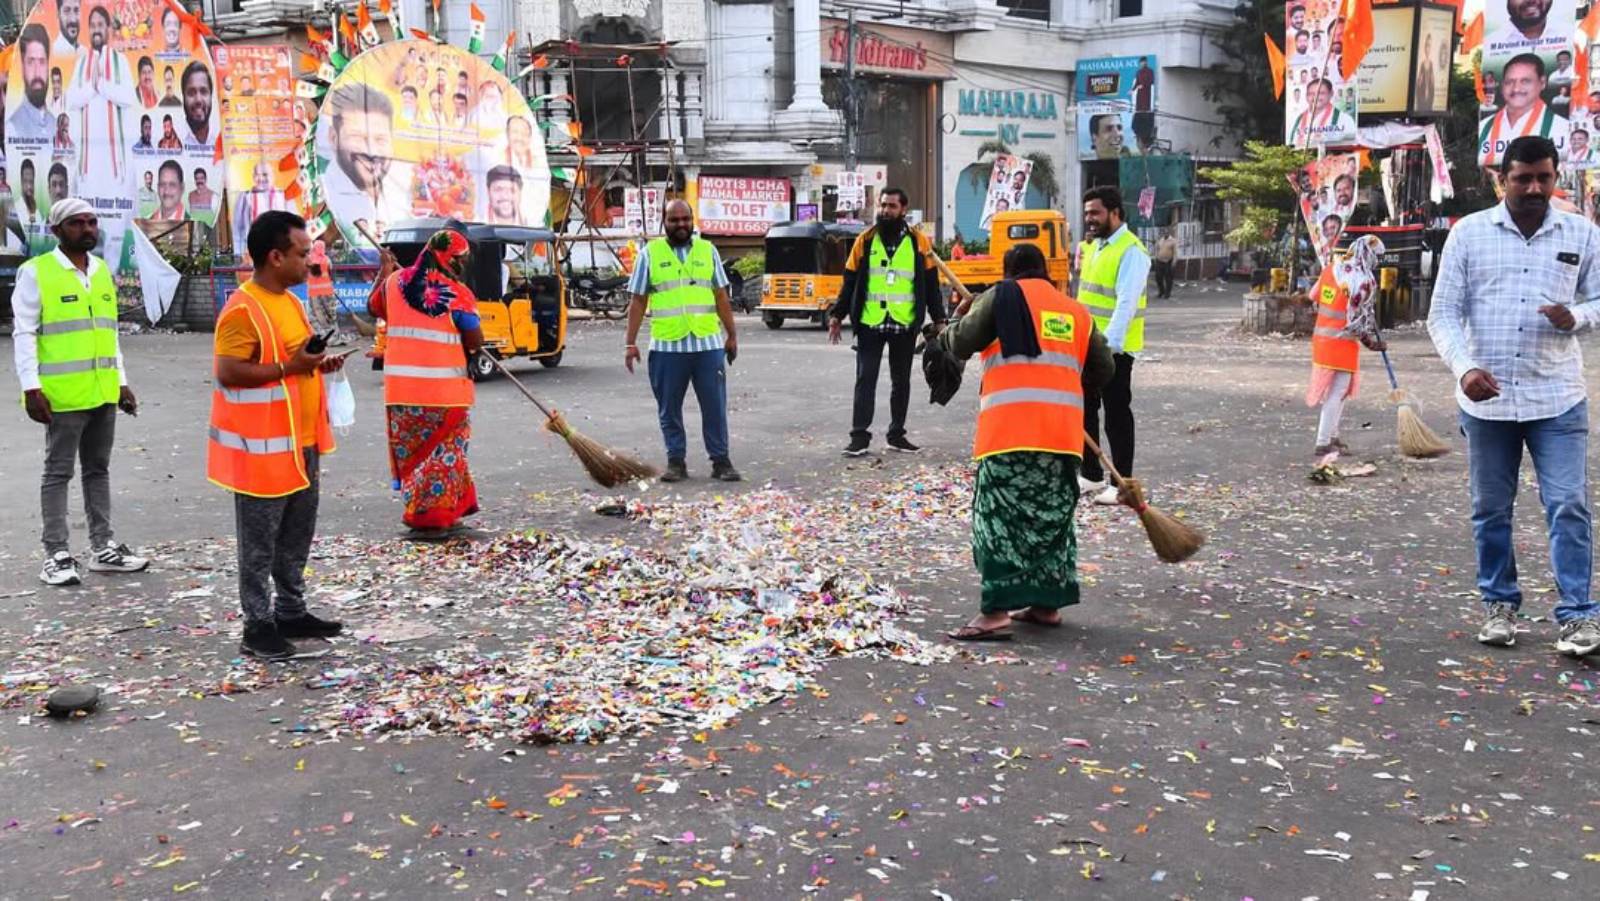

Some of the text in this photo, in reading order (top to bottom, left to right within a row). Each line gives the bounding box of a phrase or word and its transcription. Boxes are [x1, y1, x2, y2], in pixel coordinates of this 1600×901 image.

[829, 29, 927, 70] Hldiram's
[1080, 59, 1138, 71] MAHARAJA NX
[959, 88, 1058, 119] MAHARAJA
[998, 123, 1020, 145] NX
[752, 179, 786, 191] ICHA
[702, 189, 787, 201] MAHAL MARKET
[95, 196, 114, 209] Kumar
[703, 220, 773, 233] 97011663
